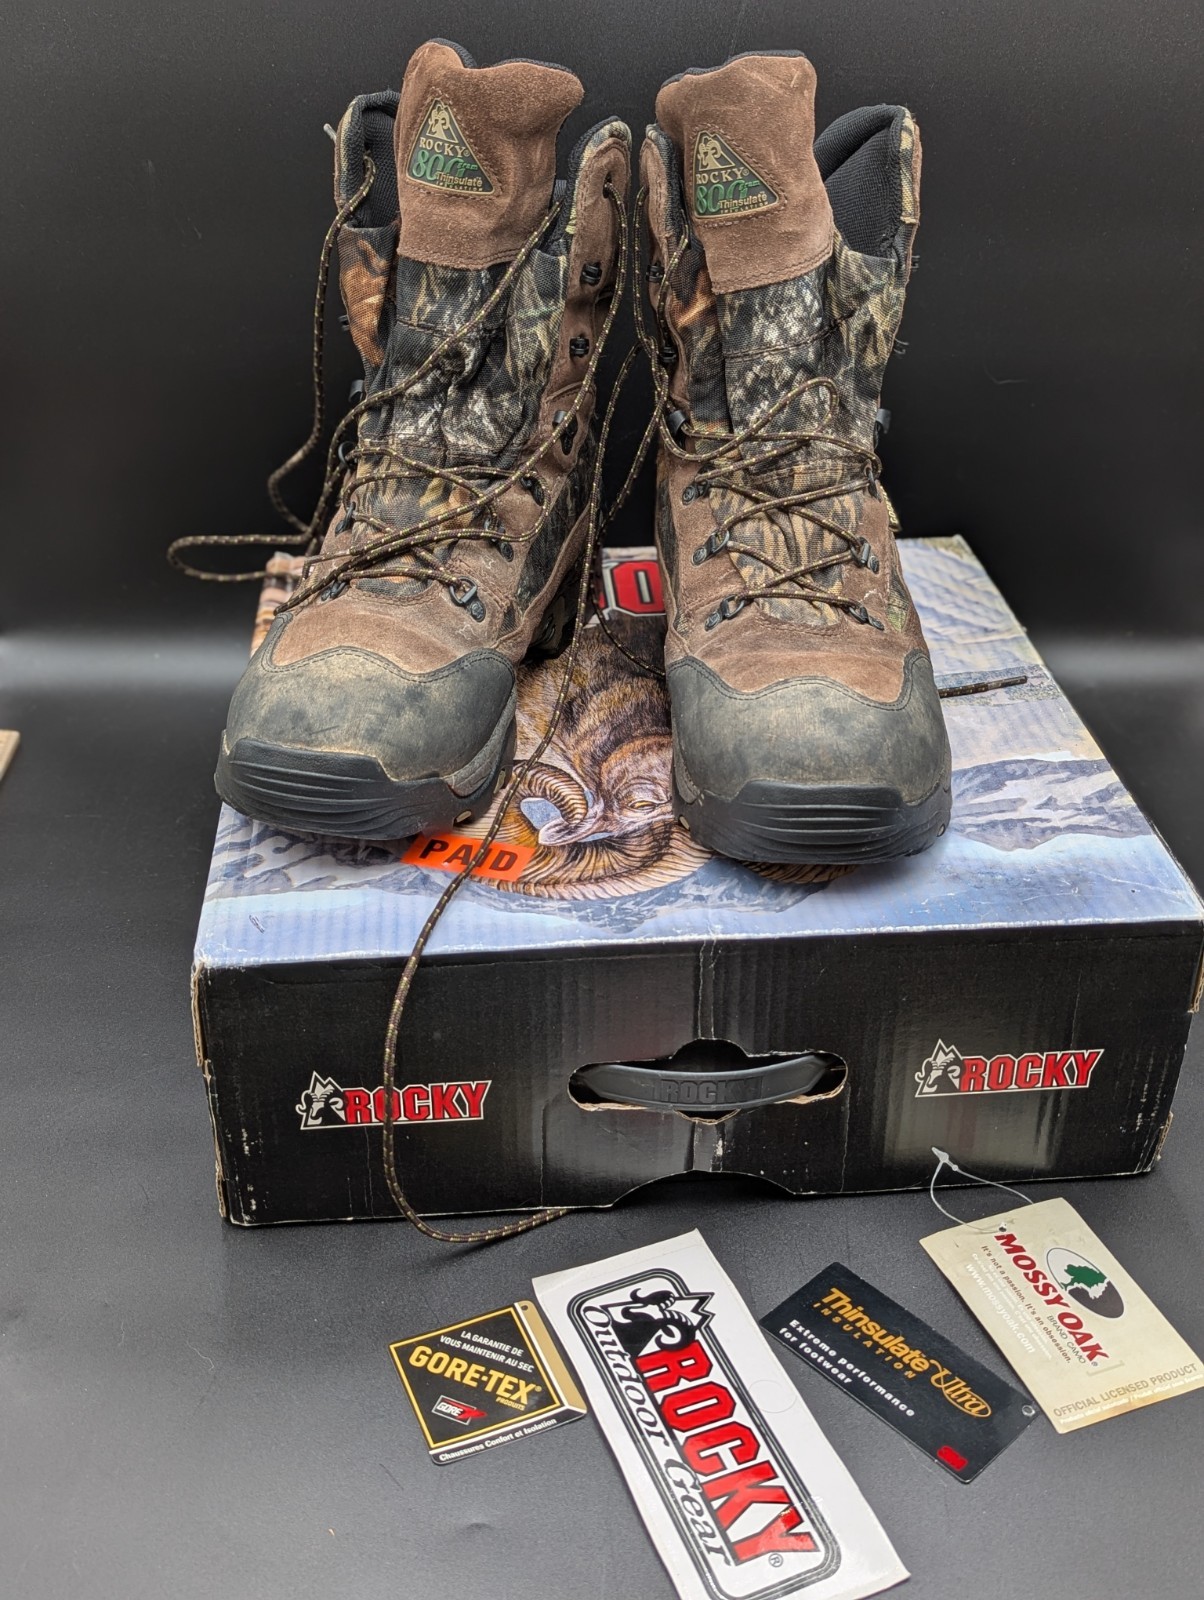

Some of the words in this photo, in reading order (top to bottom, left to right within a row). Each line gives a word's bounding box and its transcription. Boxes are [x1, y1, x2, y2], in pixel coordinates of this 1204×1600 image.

[419, 137, 466, 157] ROCKY
[436, 171, 483, 188] Thinsulate
[696, 167, 745, 184] ROCKY
[720, 192, 768, 208] Thinsulate
[419, 839, 518, 872] PAID
[661, 1076, 757, 1104] ROCKY
[960, 1051, 1100, 1092] ROCKY
[344, 1082, 490, 1124] ROCKY
[966, 1263, 1036, 1354] www.mossyoak.com
[981, 1245, 992, 1257] It's
[991, 1258, 1002, 1269] not
[1003, 1275, 1026, 1302] passion.
[1025, 1303, 1036, 1315] It's
[1035, 1316, 1044, 1325] an
[1043, 1326, 1071, 1363] obsession.
[994, 1233, 1070, 1308] MOSSY
[1057, 1312, 1109, 1362] OAK
[440, 1335, 461, 1349] VOUS
[463, 1343, 505, 1363] MAINTENIR
[505, 1357, 518, 1367] AU
[518, 1361, 534, 1373] SEC
[461, 1331, 471, 1340] LA
[472, 1333, 511, 1353] GARANTIE
[511, 1347, 524, 1357] DE
[779, 1327, 798, 1343] for
[799, 1341, 853, 1384] footwear
[813, 1302, 917, 1380] INSULATION
[821, 1287, 931, 1373] Thinsulate
[930, 1359, 992, 1418] Ultra
[1046, 1315, 1068, 1340] BRAND
[1066, 1341, 1087, 1364] CAMO
[789, 1319, 837, 1357] Extreme
[837, 1355, 915, 1417] performance
[1053, 1396, 1100, 1417] OFFICIAL
[1100, 1380, 1149, 1402] LICENSED
[1149, 1363, 1197, 1386] PRODUCT
[436, 1401, 464, 1417] GORE
[439, 1443, 485, 1462] Chaussures
[485, 1433, 514, 1448] Confort
[514, 1430, 523, 1438] et
[524, 1418, 557, 1435] Isolation
[583, 1306, 671, 1448] Outdoor
[664, 1458, 732, 1567] Gear
[635, 1340, 821, 1567] ROCKY
